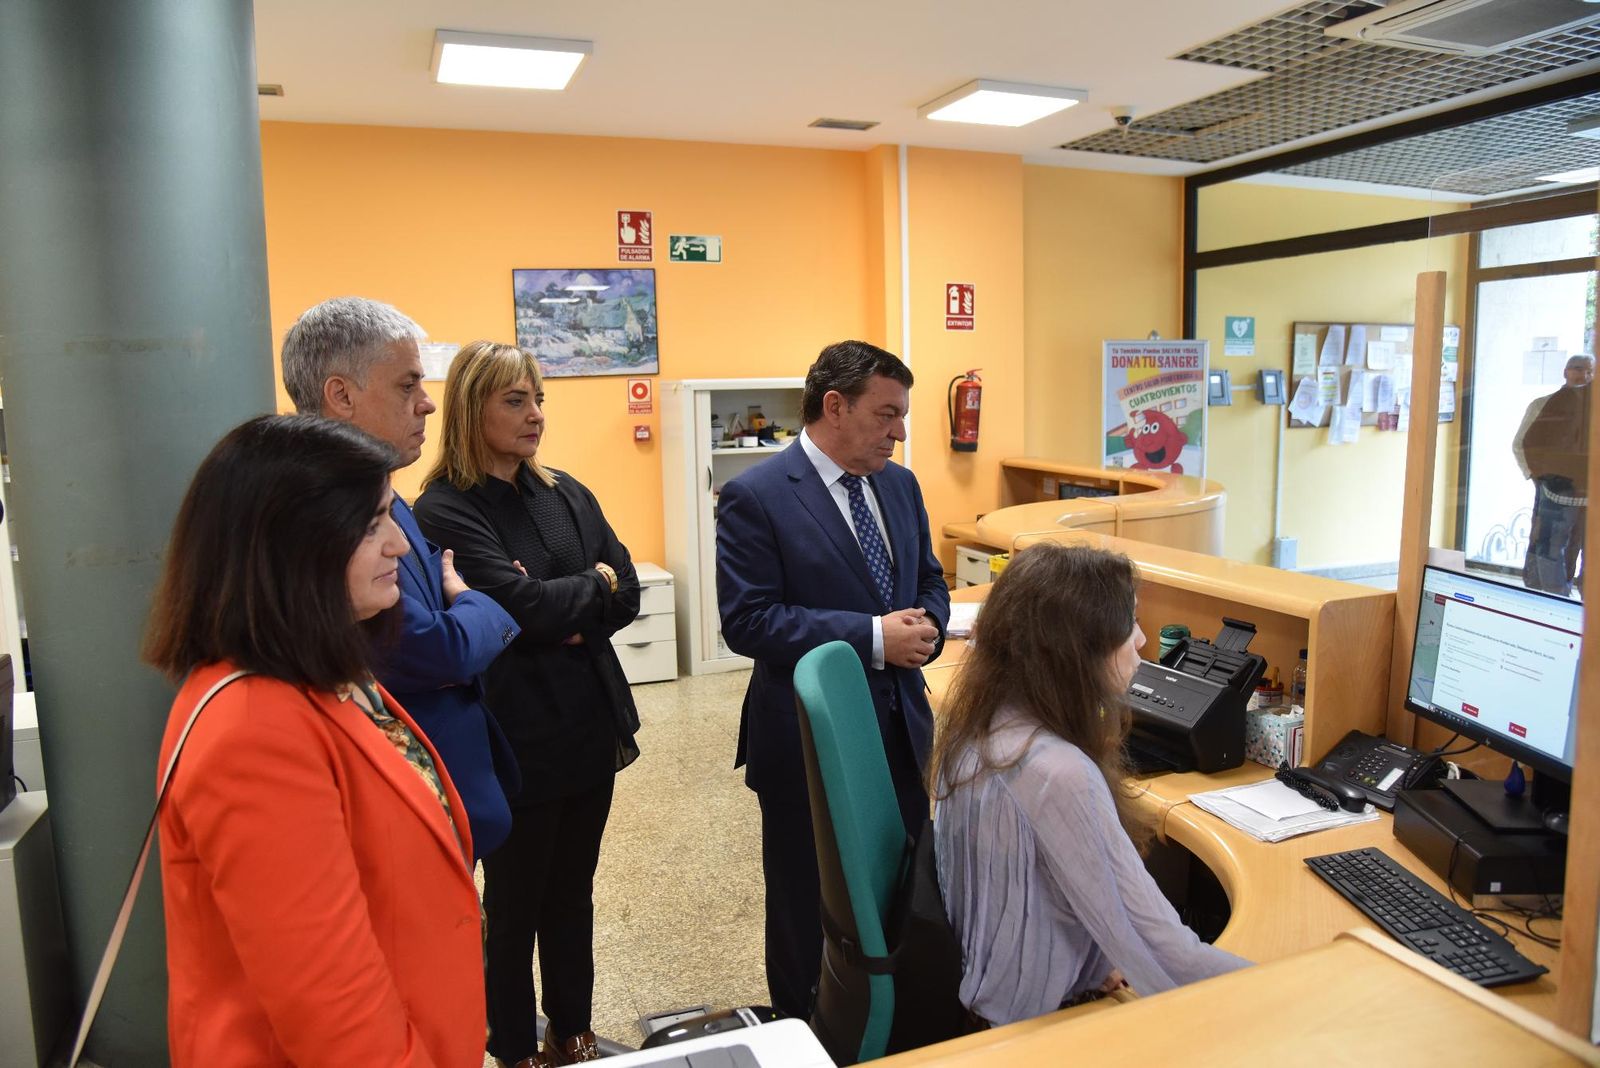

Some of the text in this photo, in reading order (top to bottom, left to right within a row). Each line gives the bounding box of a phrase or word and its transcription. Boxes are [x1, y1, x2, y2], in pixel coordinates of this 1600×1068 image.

[1111, 355, 1199, 369] DONA TU SANGRE
[1128, 384, 1198, 409] CUATROVIENTOS
